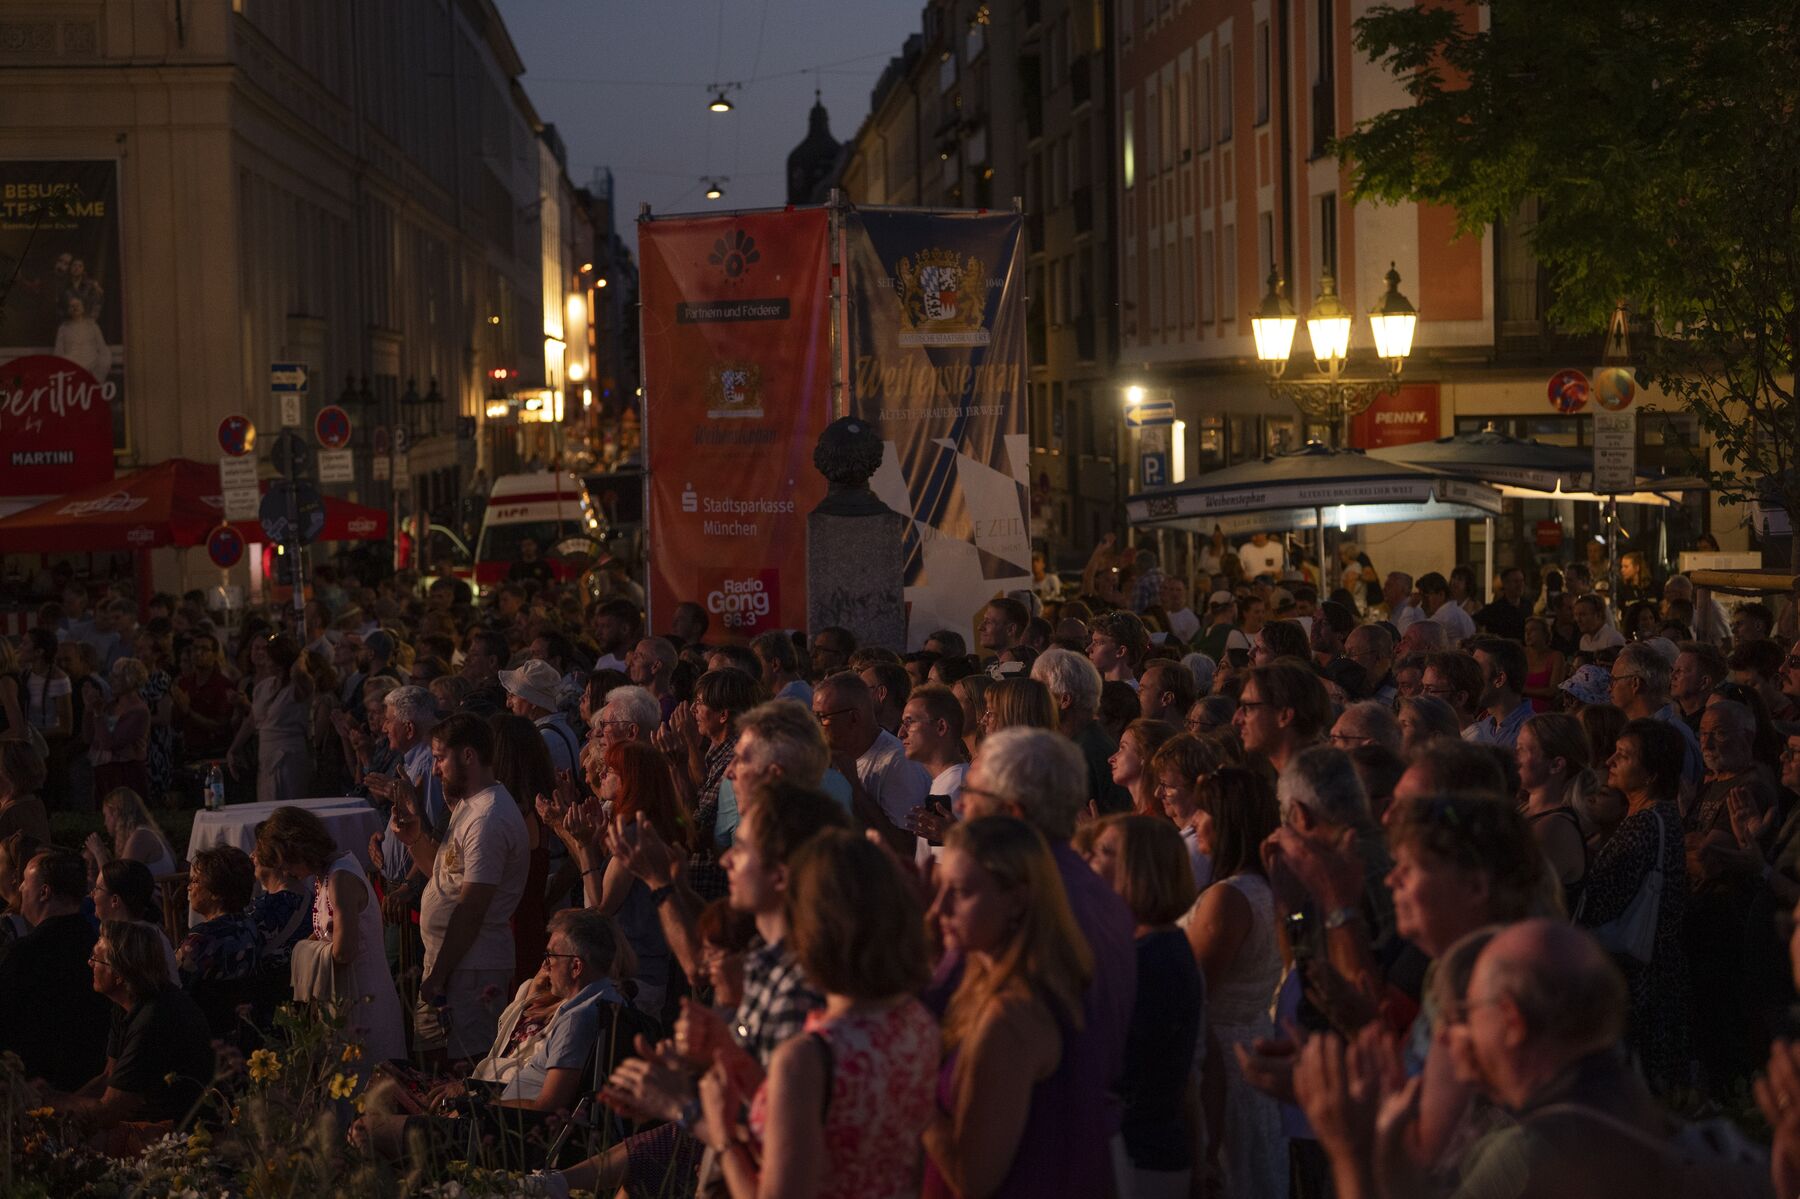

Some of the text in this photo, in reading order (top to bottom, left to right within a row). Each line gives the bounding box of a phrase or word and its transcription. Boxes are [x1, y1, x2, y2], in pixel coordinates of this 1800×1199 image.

[985, 278, 1004, 288] 1040
[685, 304, 781, 319] Partnern und Förderer
[981, 403, 1005, 416] WELT
[25, 416, 43, 434] by
[12, 451, 74, 466] MARTINI
[1145, 457, 1159, 484] P
[703, 497, 795, 517] Stadtsparkasse
[703, 519, 758, 536] München
[724, 577, 764, 593] Radio
[707, 590, 770, 616] Gong
[723, 608, 757, 628] 96.3
